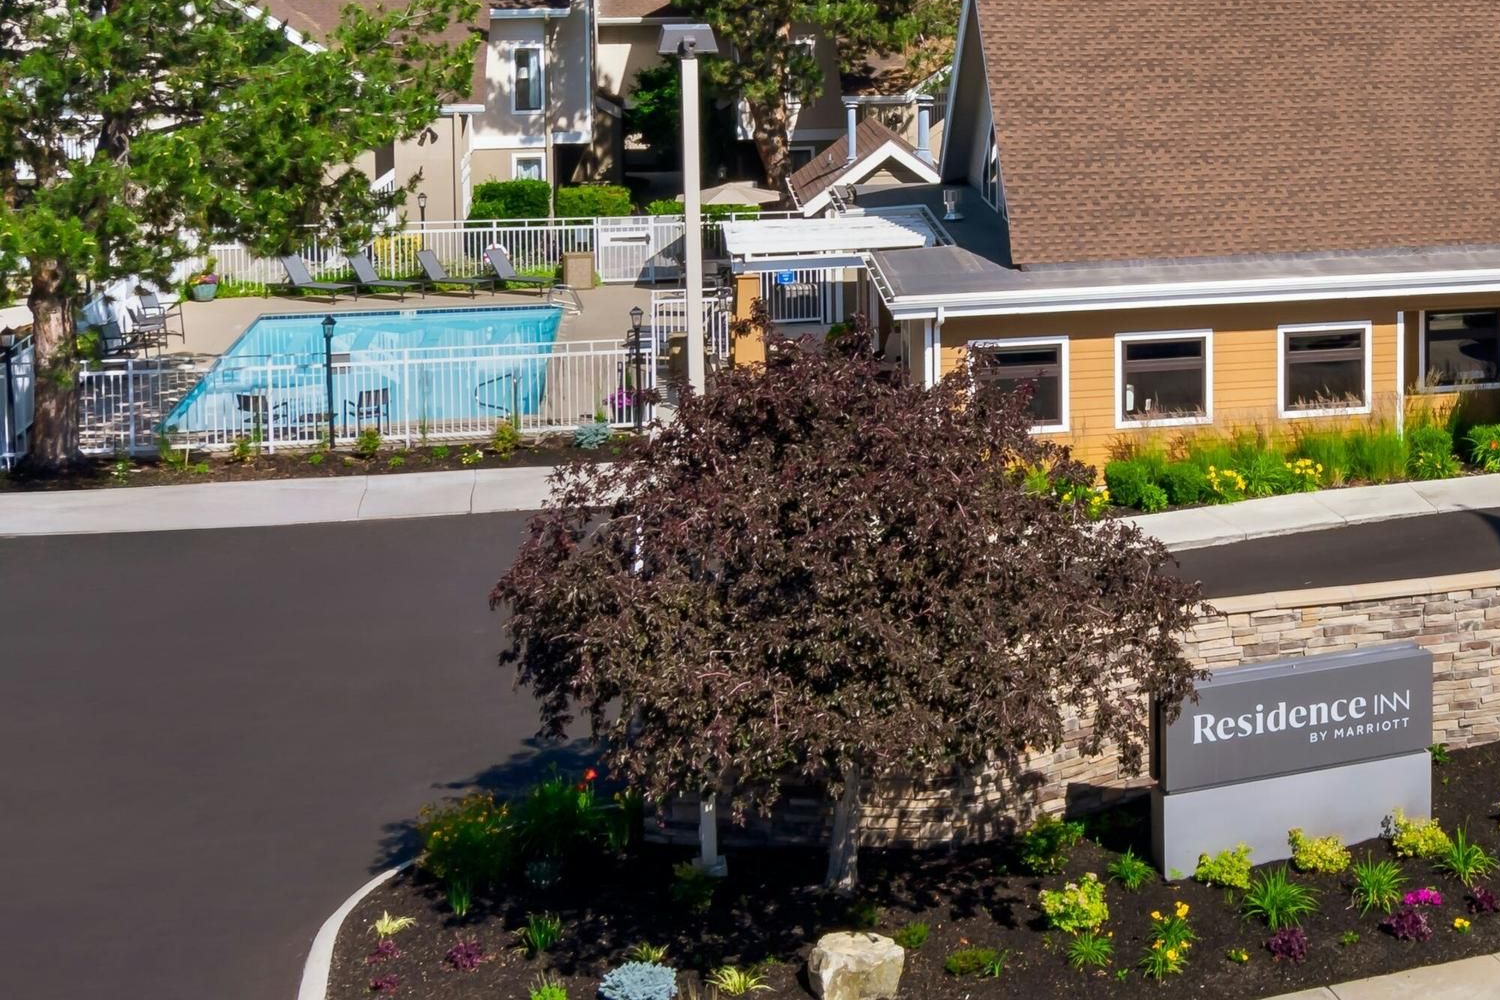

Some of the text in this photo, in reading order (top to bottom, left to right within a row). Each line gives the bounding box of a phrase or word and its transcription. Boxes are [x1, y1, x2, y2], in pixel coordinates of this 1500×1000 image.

[1193, 689, 1410, 744] Residence INN
[1309, 717, 1410, 743] BY MARRIOTT
